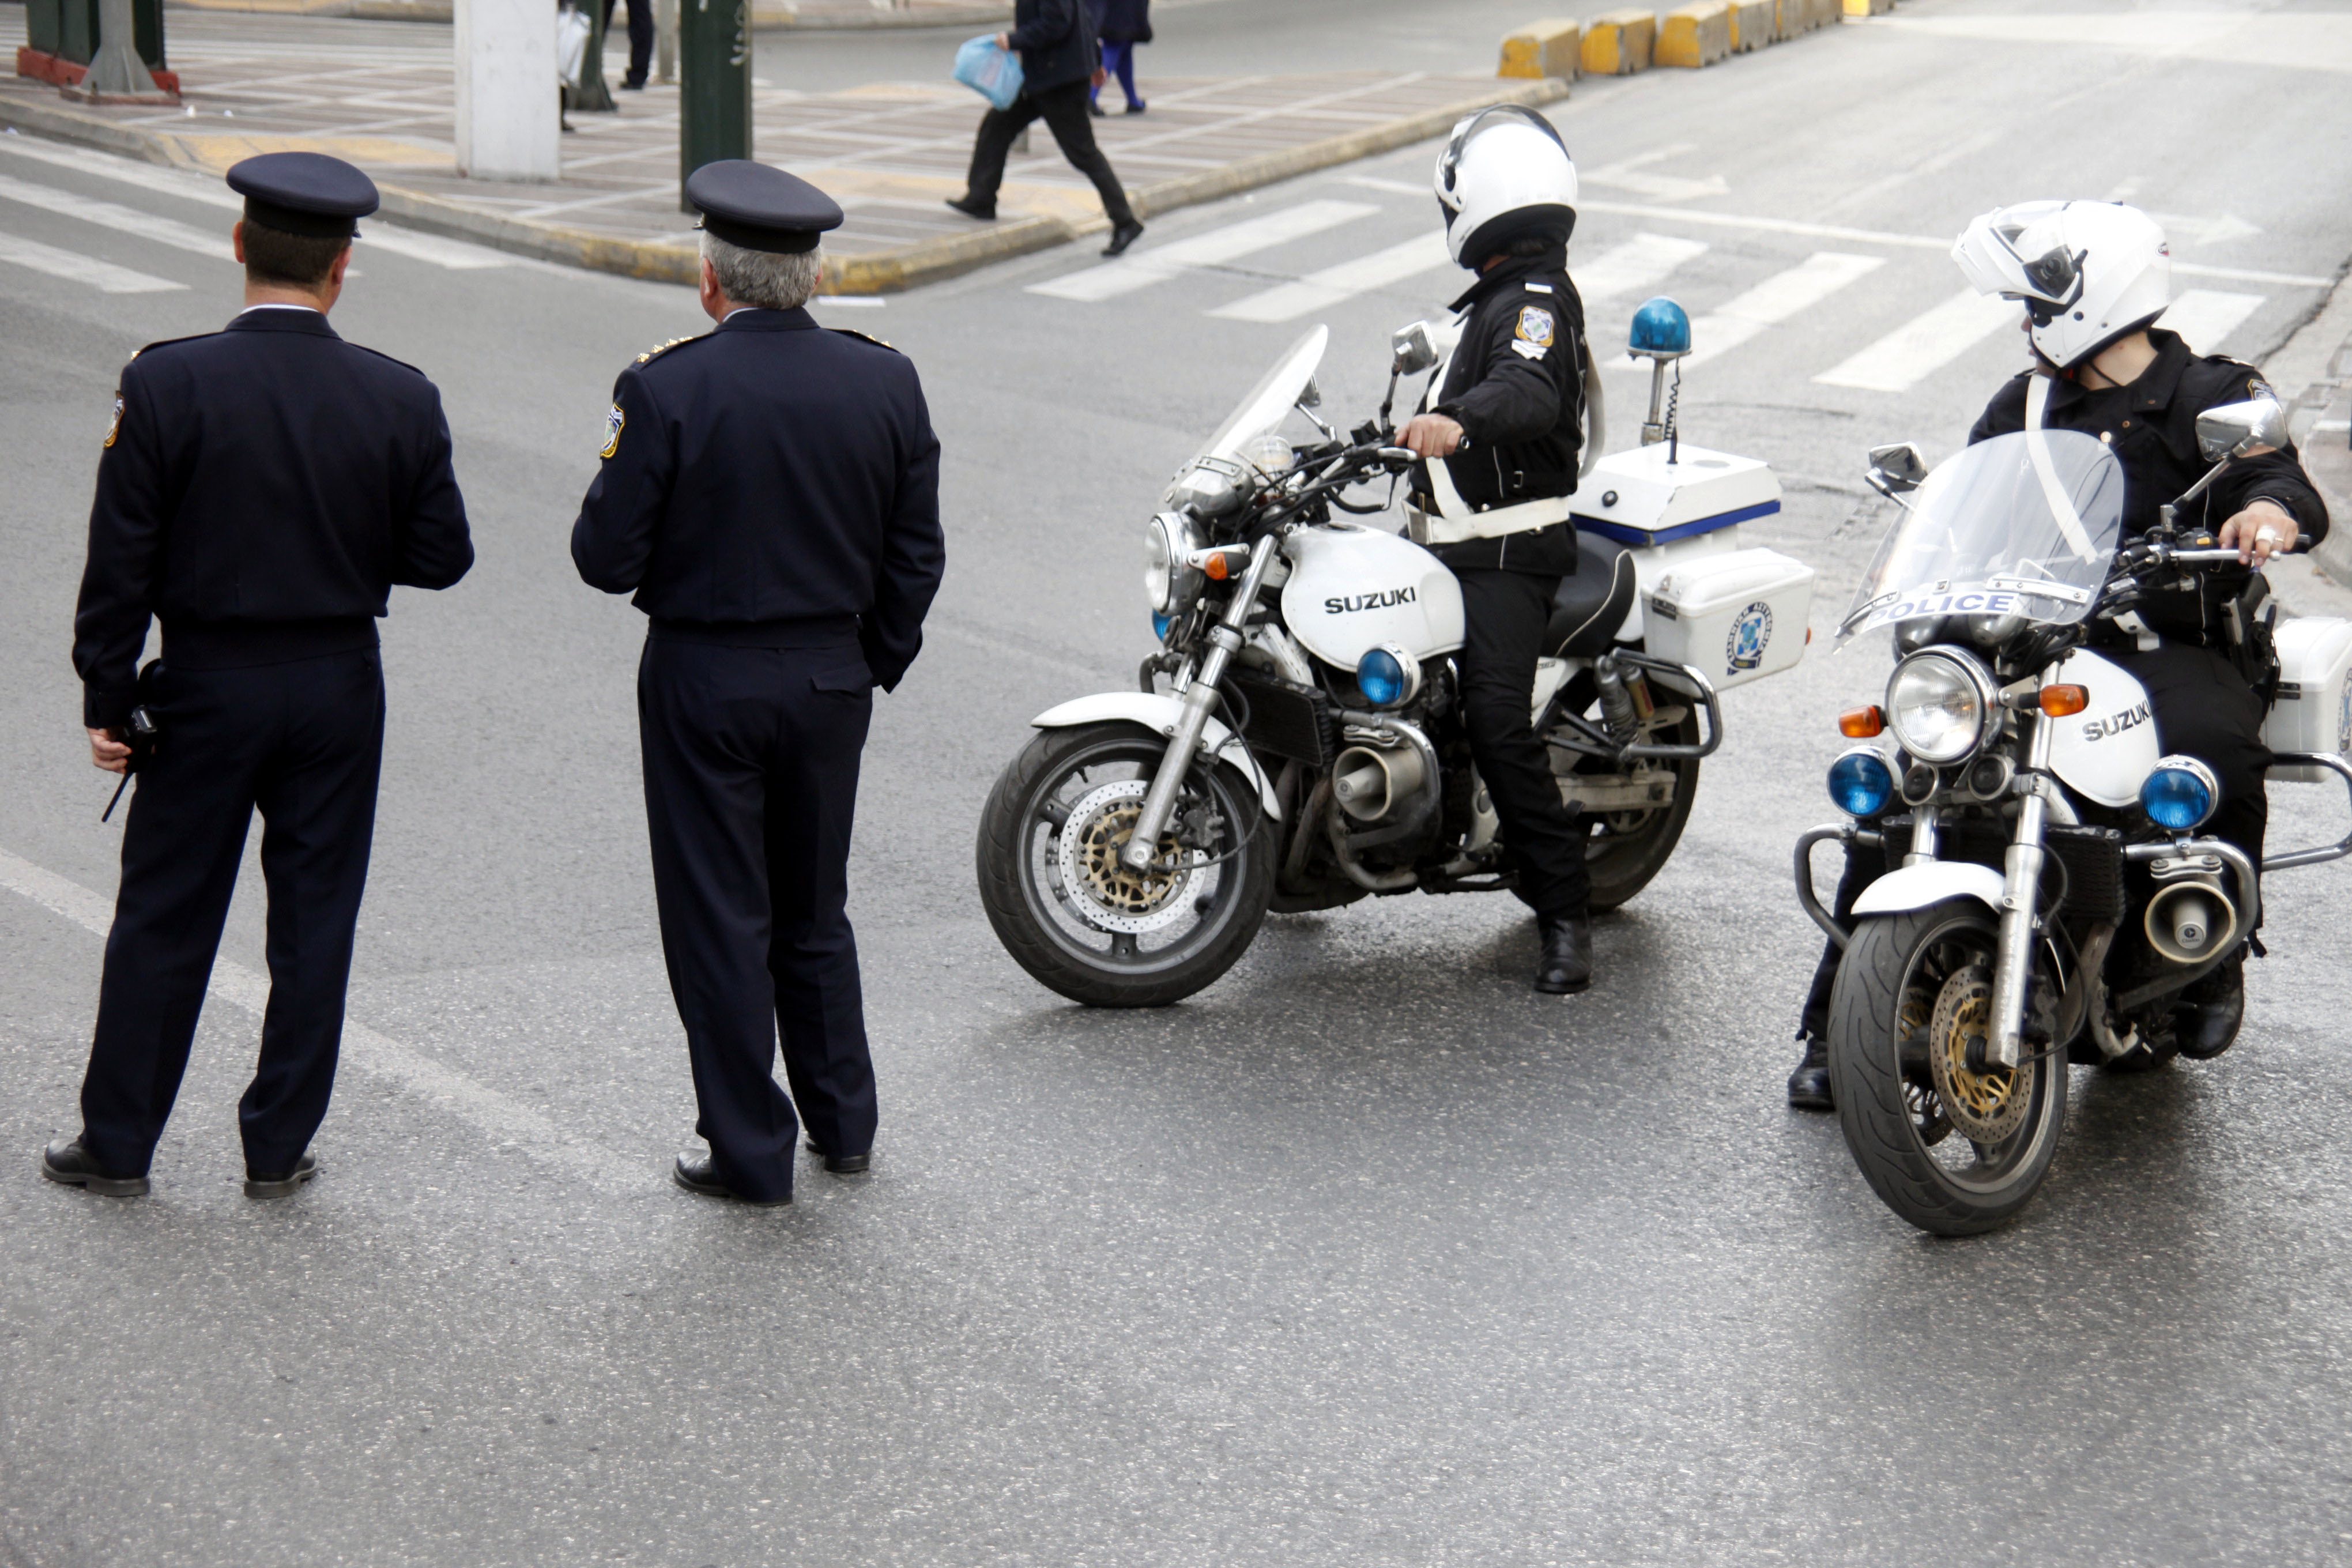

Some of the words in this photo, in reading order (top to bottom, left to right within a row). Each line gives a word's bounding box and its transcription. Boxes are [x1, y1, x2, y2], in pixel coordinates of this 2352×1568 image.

[1324, 586, 1416, 614] SUZUKI
[1869, 595, 2014, 624] POLICE
[2082, 700, 2151, 741] SUZUKI
